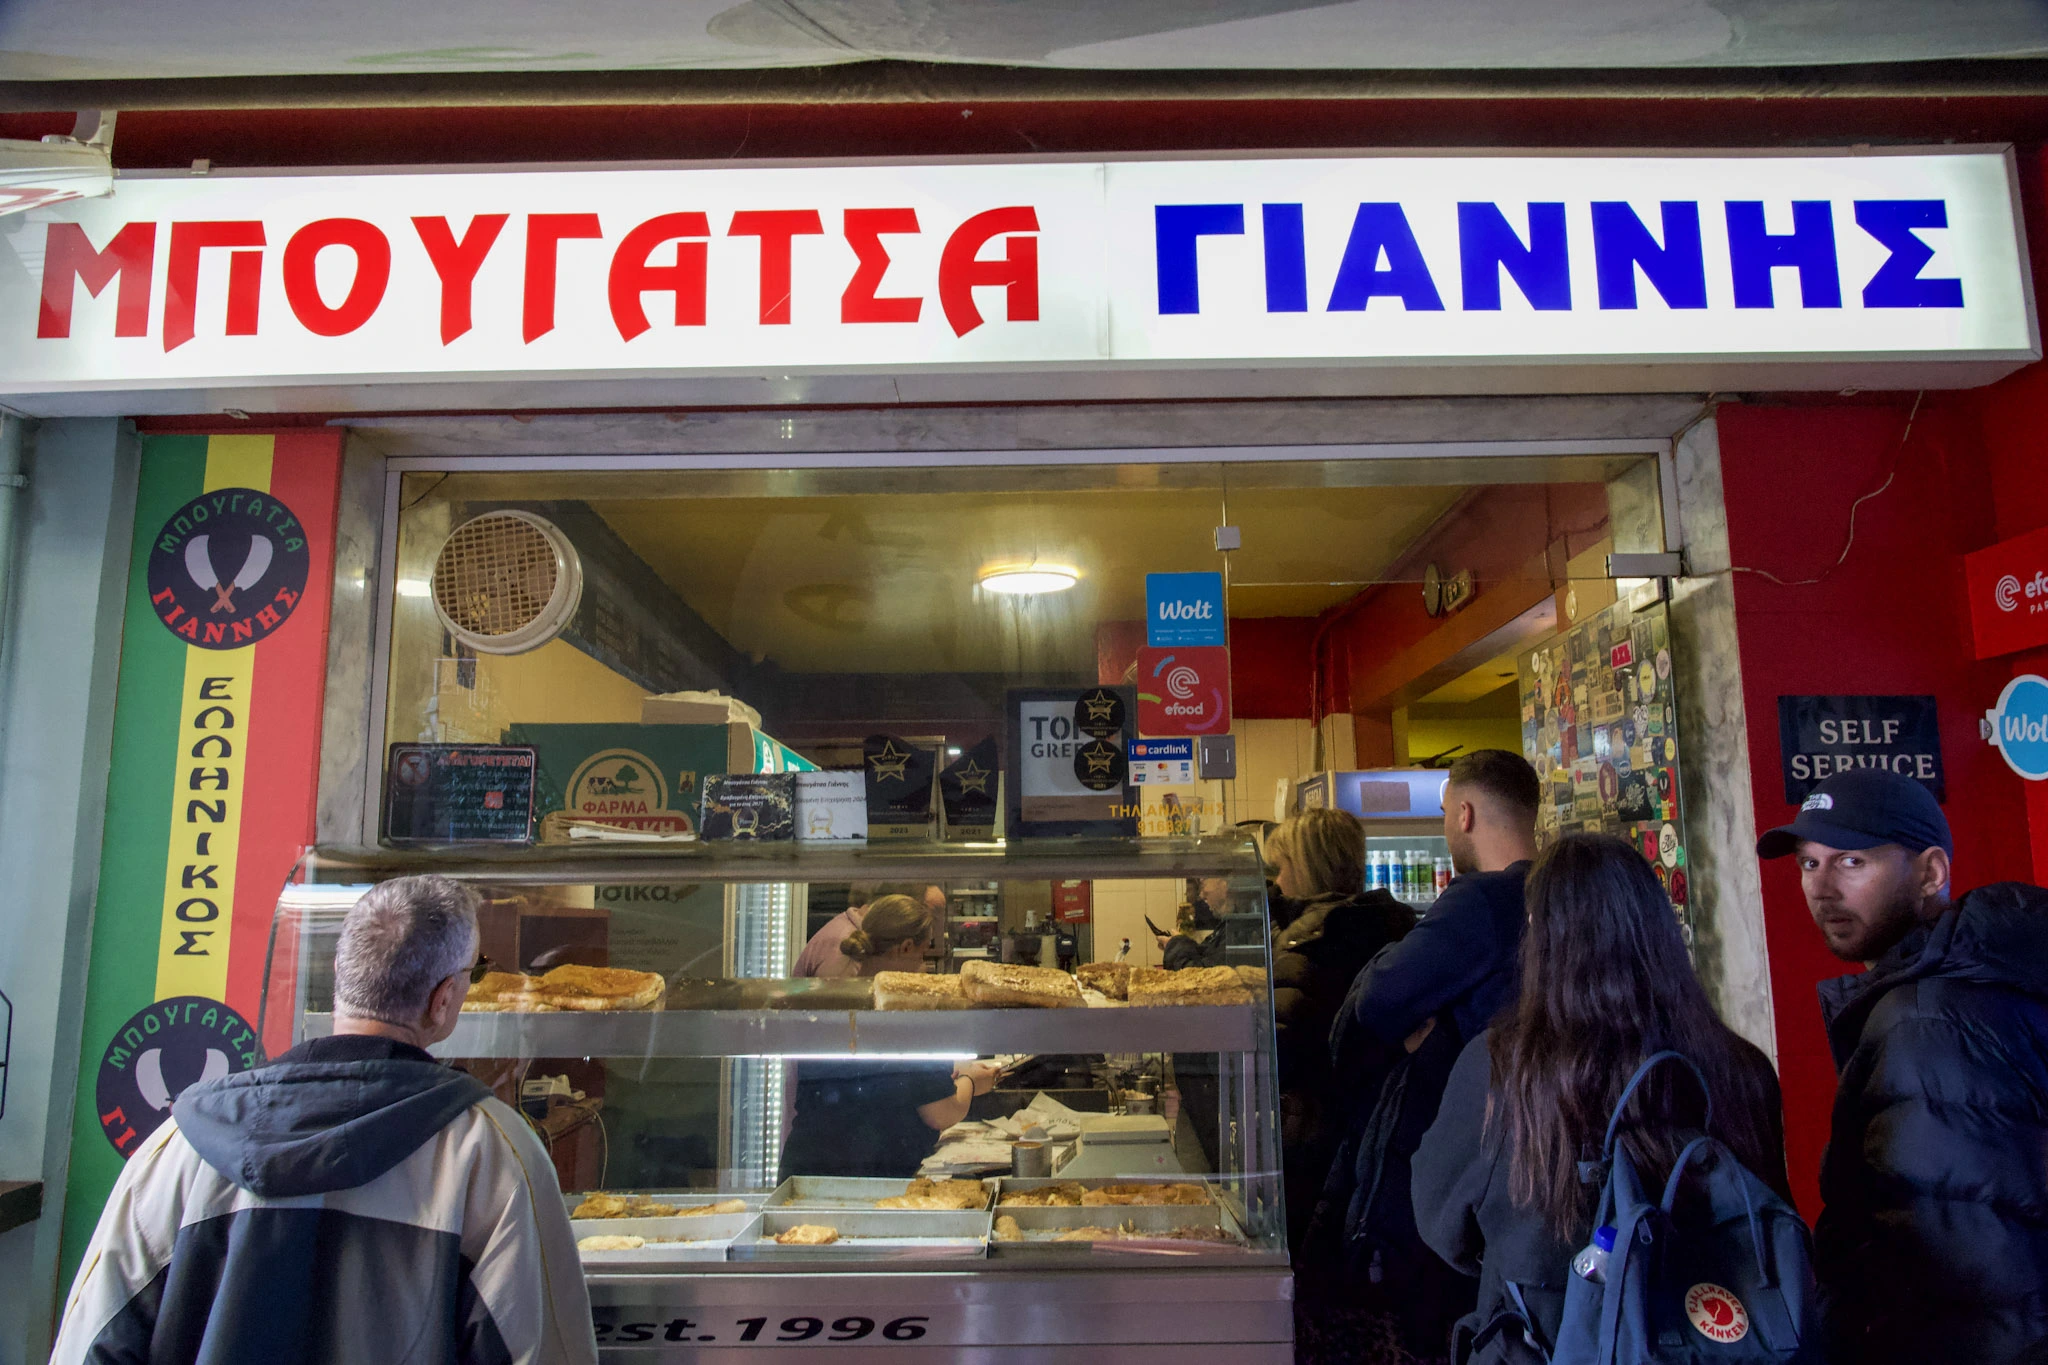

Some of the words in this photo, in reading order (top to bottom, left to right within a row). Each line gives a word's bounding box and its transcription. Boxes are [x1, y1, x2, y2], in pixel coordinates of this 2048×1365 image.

[38, 206, 1040, 352] ΜΠΟΥΓΑΤΣΑ
[1155, 200, 1963, 314] ΓΙΑΝΝΗΣ
[158, 494, 304, 554] ΜΠΟΥΓΑΤΣΑ
[152, 586, 299, 644] ΓΙΑΝΝΗΣ
[1159, 599, 1213, 620] Wolt
[1164, 702, 1204, 716] efood
[1819, 719, 1900, 744] SELF
[1148, 744, 1188, 755] cardlink
[174, 677, 235, 956] ΕΛΛΗΝΙΚΟΣ
[583, 801, 648, 814] ΦΑΡΜΑ
[735, 1316, 930, 1342] 1996
